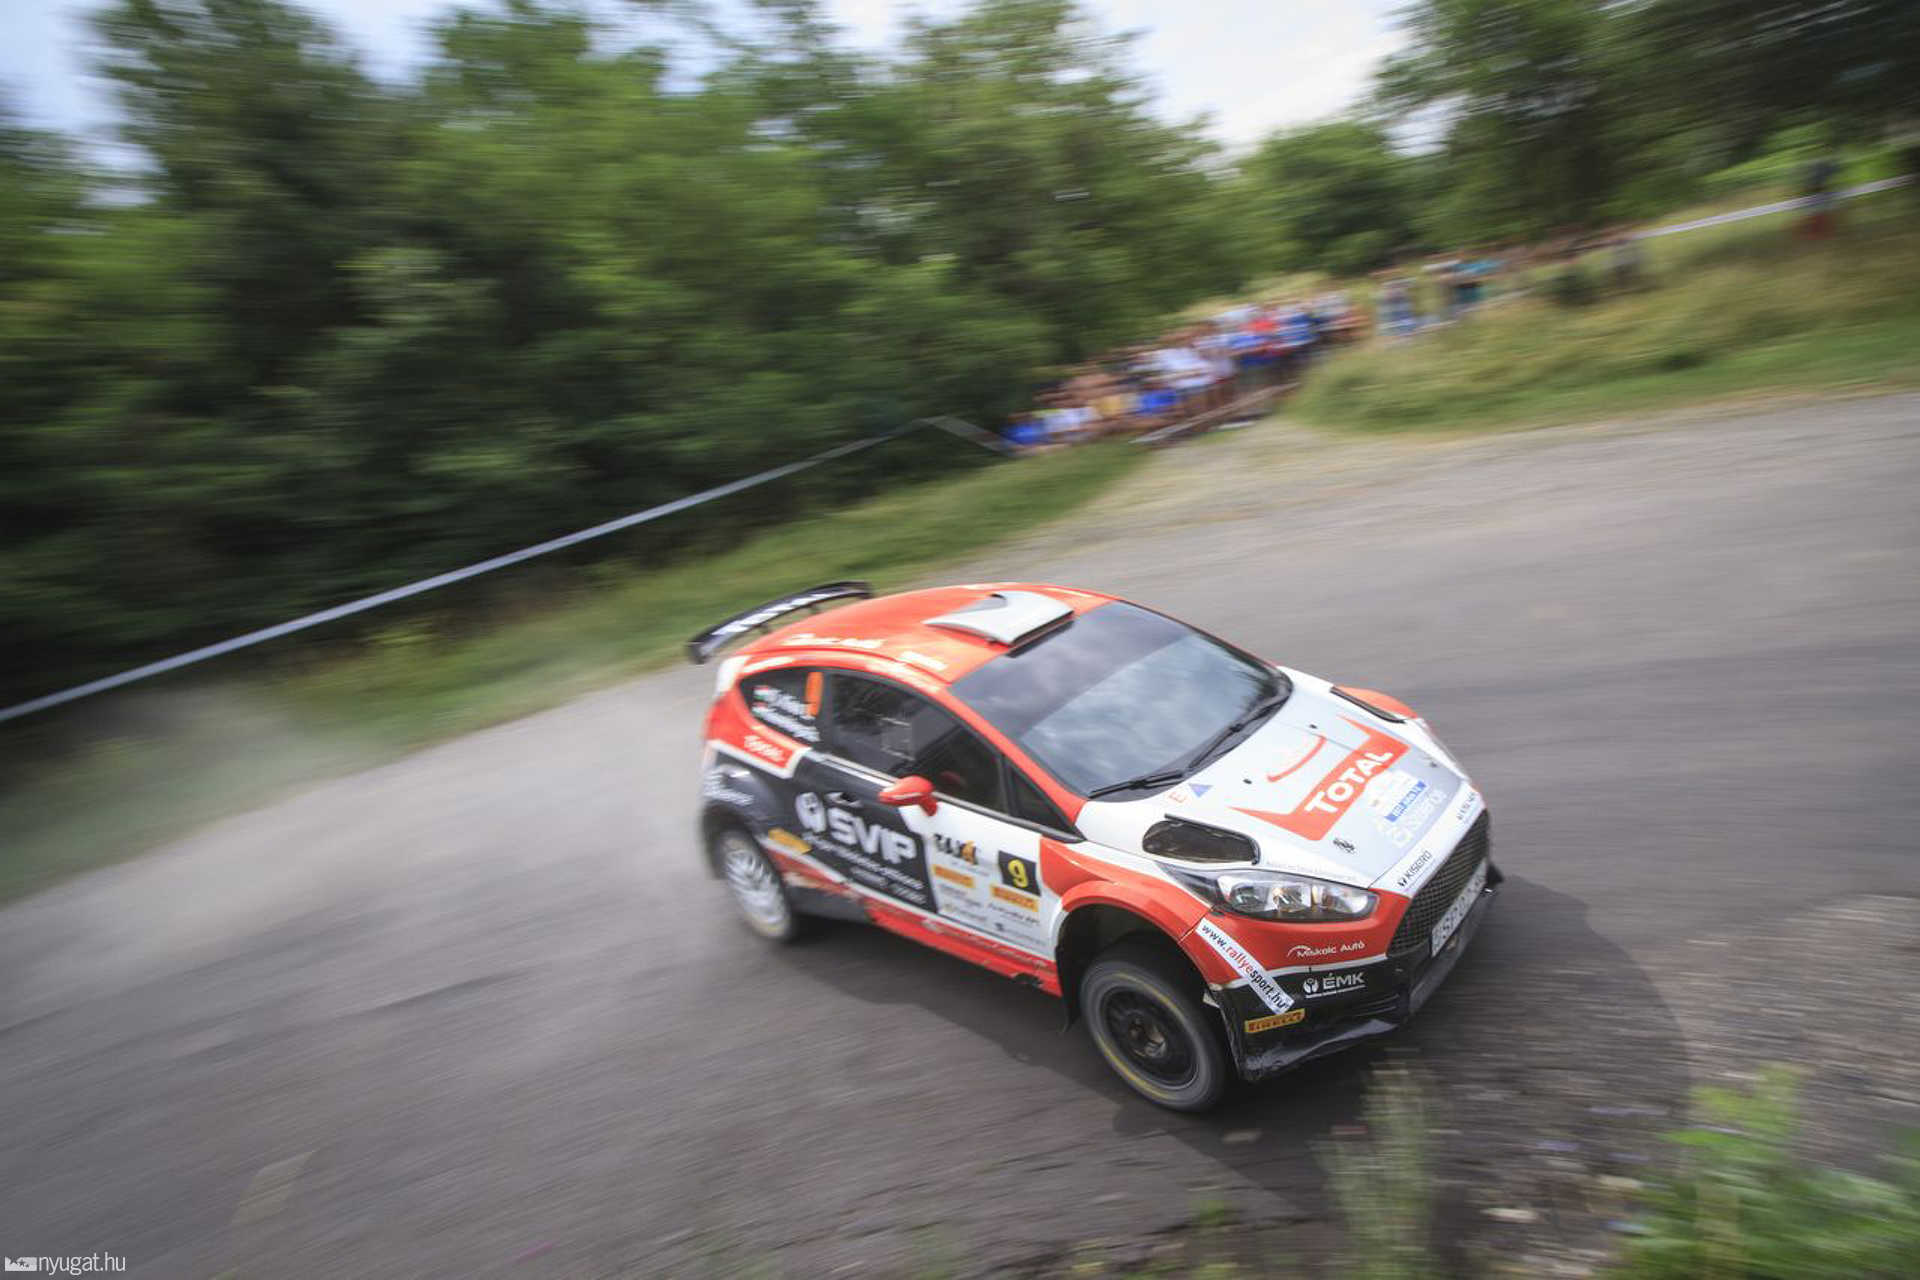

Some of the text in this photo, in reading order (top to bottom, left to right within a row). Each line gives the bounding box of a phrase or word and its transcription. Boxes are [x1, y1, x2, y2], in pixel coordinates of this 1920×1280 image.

[1304, 752, 1394, 813] TOTAL
[1008, 859, 1028, 888] 9
[1202, 925, 1287, 1009] www.rallyesport.hu
[1323, 972, 1366, 990] ÉMK
